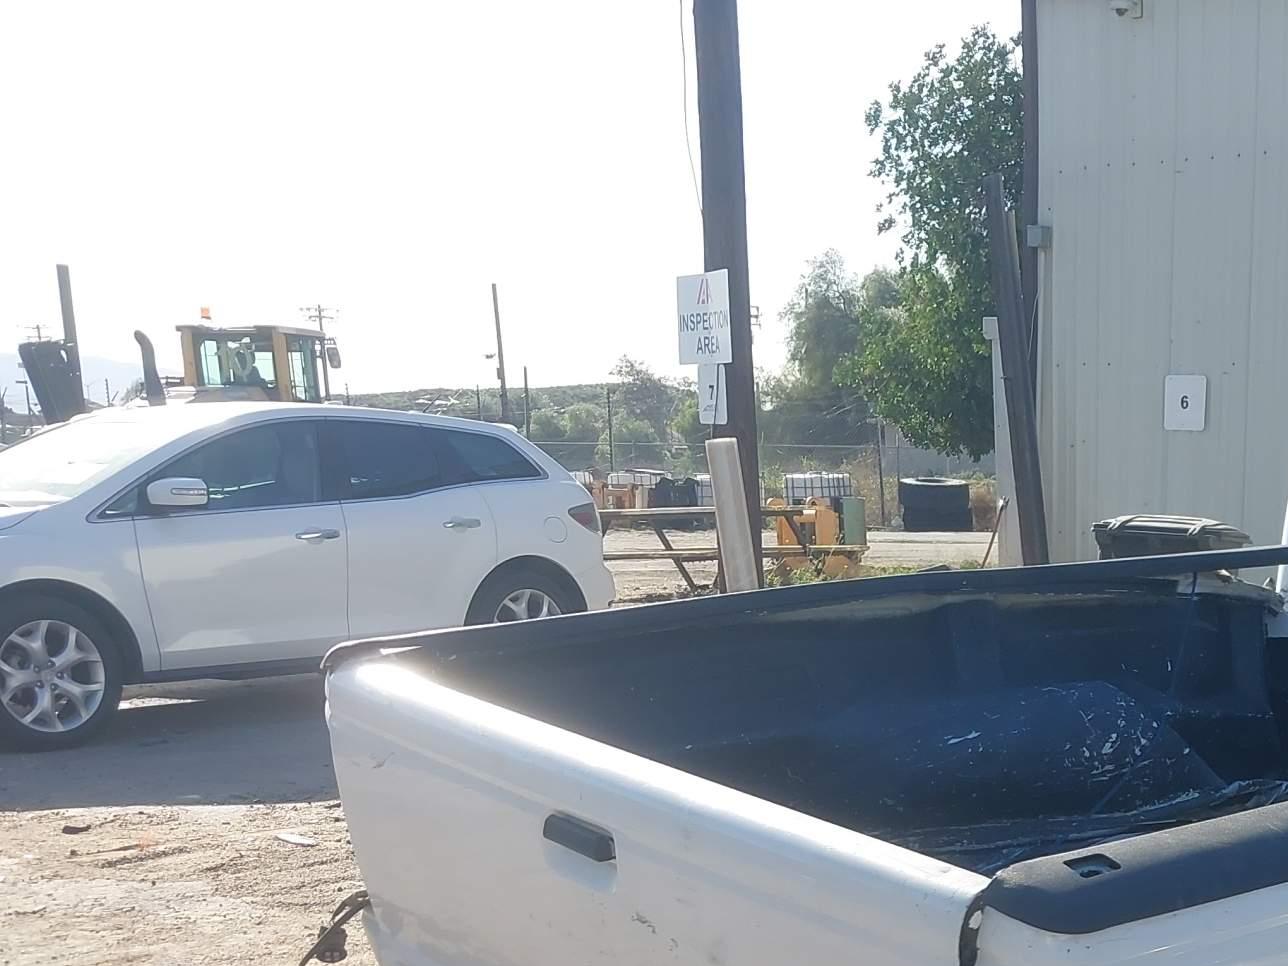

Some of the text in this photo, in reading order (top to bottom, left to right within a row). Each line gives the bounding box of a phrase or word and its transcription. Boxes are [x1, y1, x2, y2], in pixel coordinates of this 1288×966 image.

[679, 309, 729, 332] INSPECTION
[696, 336, 720, 355] AREA
[709, 385, 714, 400] 7
[1180, 395, 1189, 410] 6
